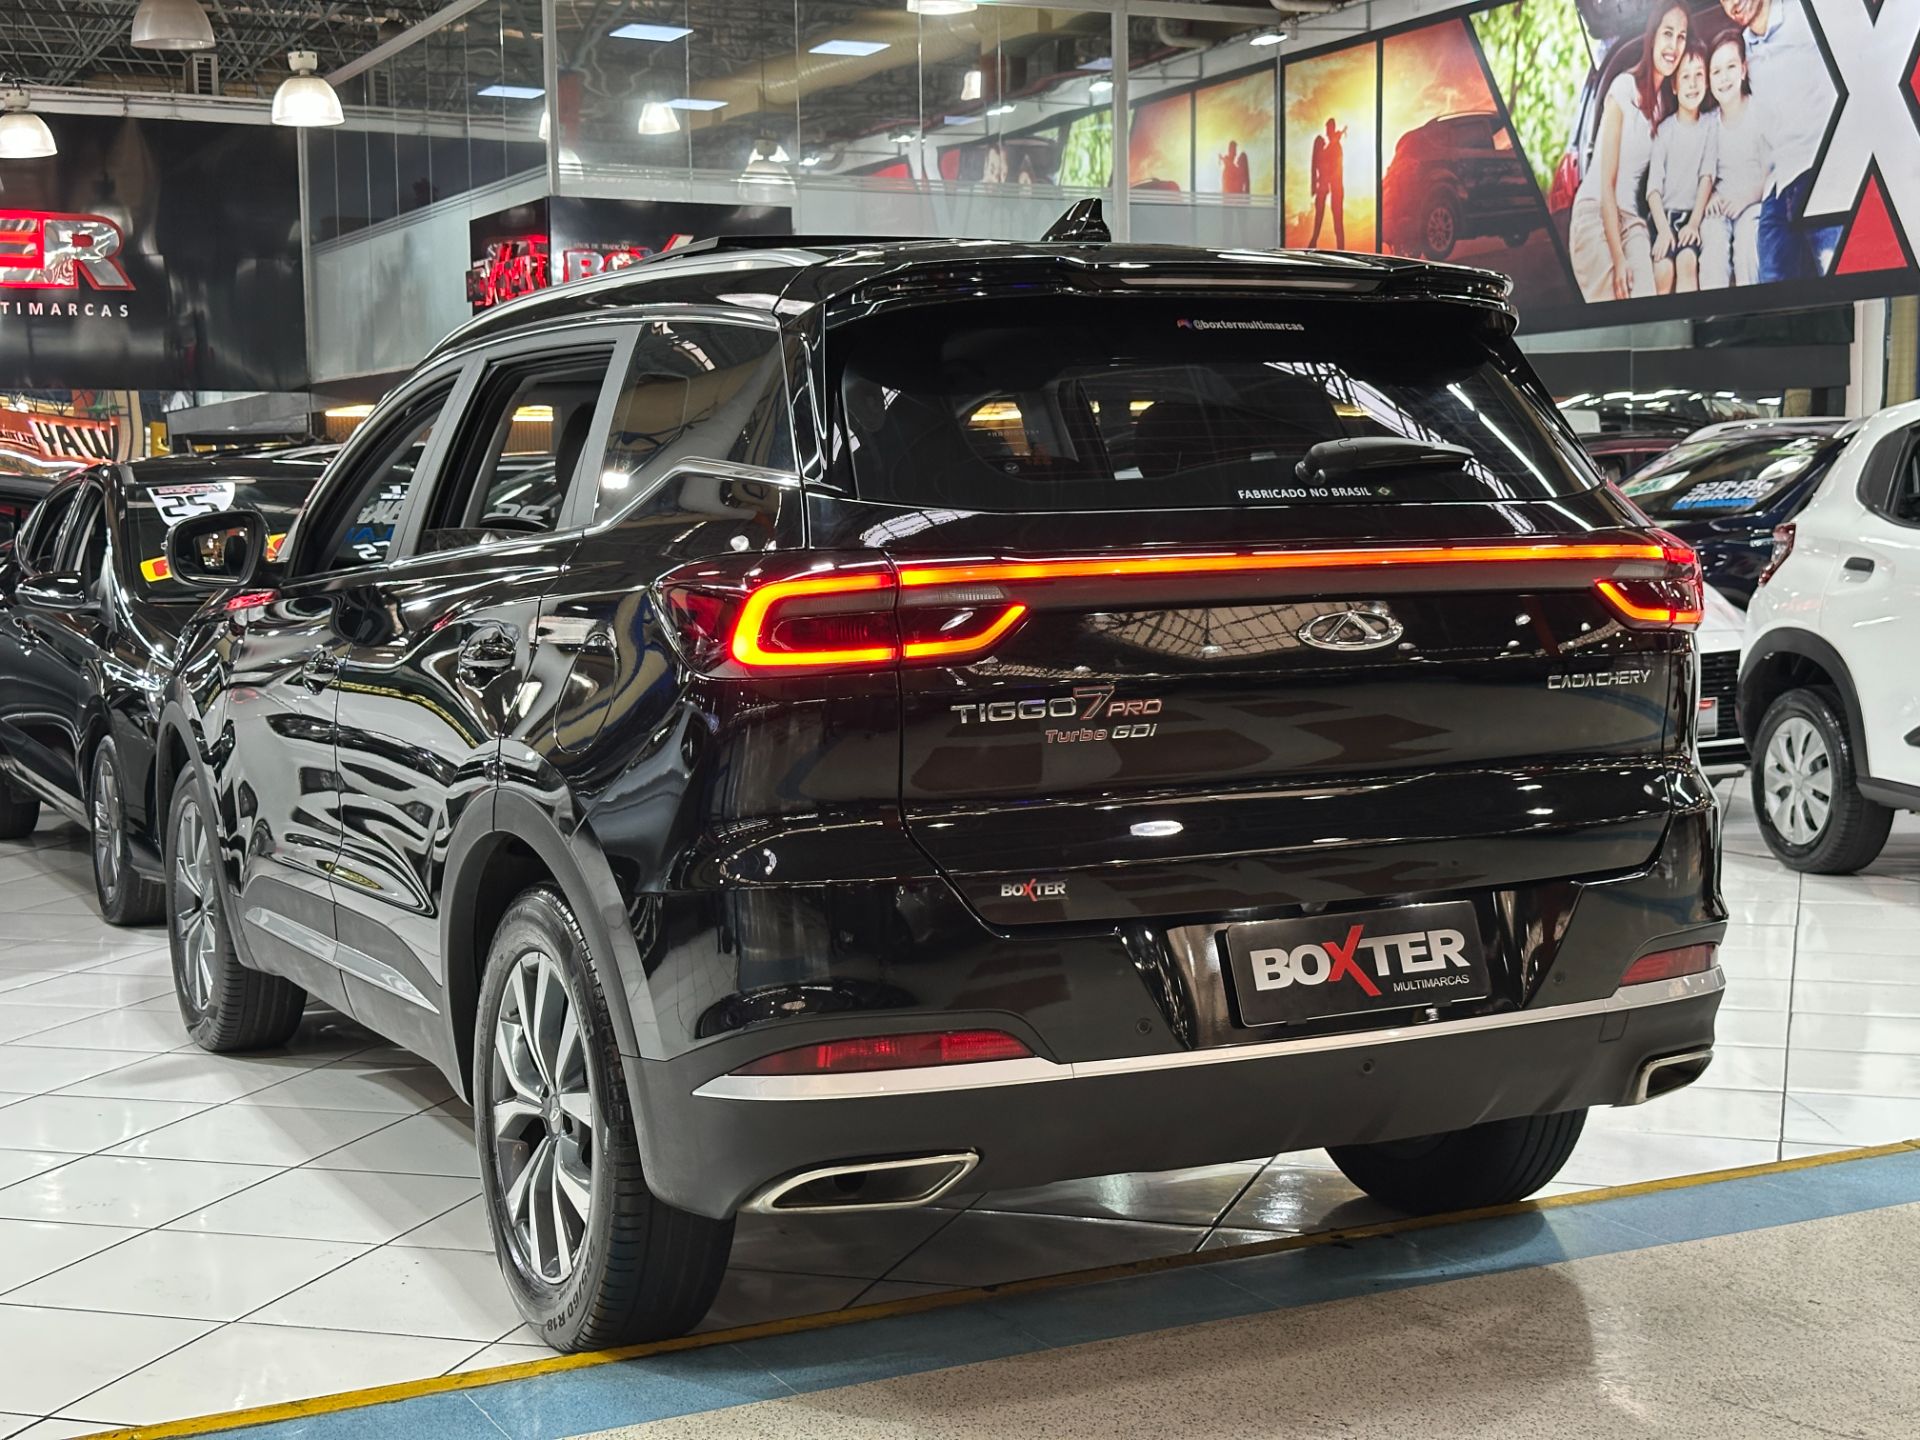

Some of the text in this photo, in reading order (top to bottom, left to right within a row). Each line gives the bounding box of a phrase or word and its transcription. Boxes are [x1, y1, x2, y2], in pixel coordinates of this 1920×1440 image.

[1192, 319, 1305, 331] @boxtermultimarcas
[1237, 486, 1372, 500] FABRICADO NO BRASIL
[1595, 669, 1651, 687] CHERY
[950, 685, 1163, 724] TIGGO 7 PRO
[1045, 728, 1108, 744] Turbo
[1001, 878, 1067, 902] BOXTER
[1250, 924, 1471, 997] BOXTER
[1393, 975, 1470, 992] MULTIMARCAS
